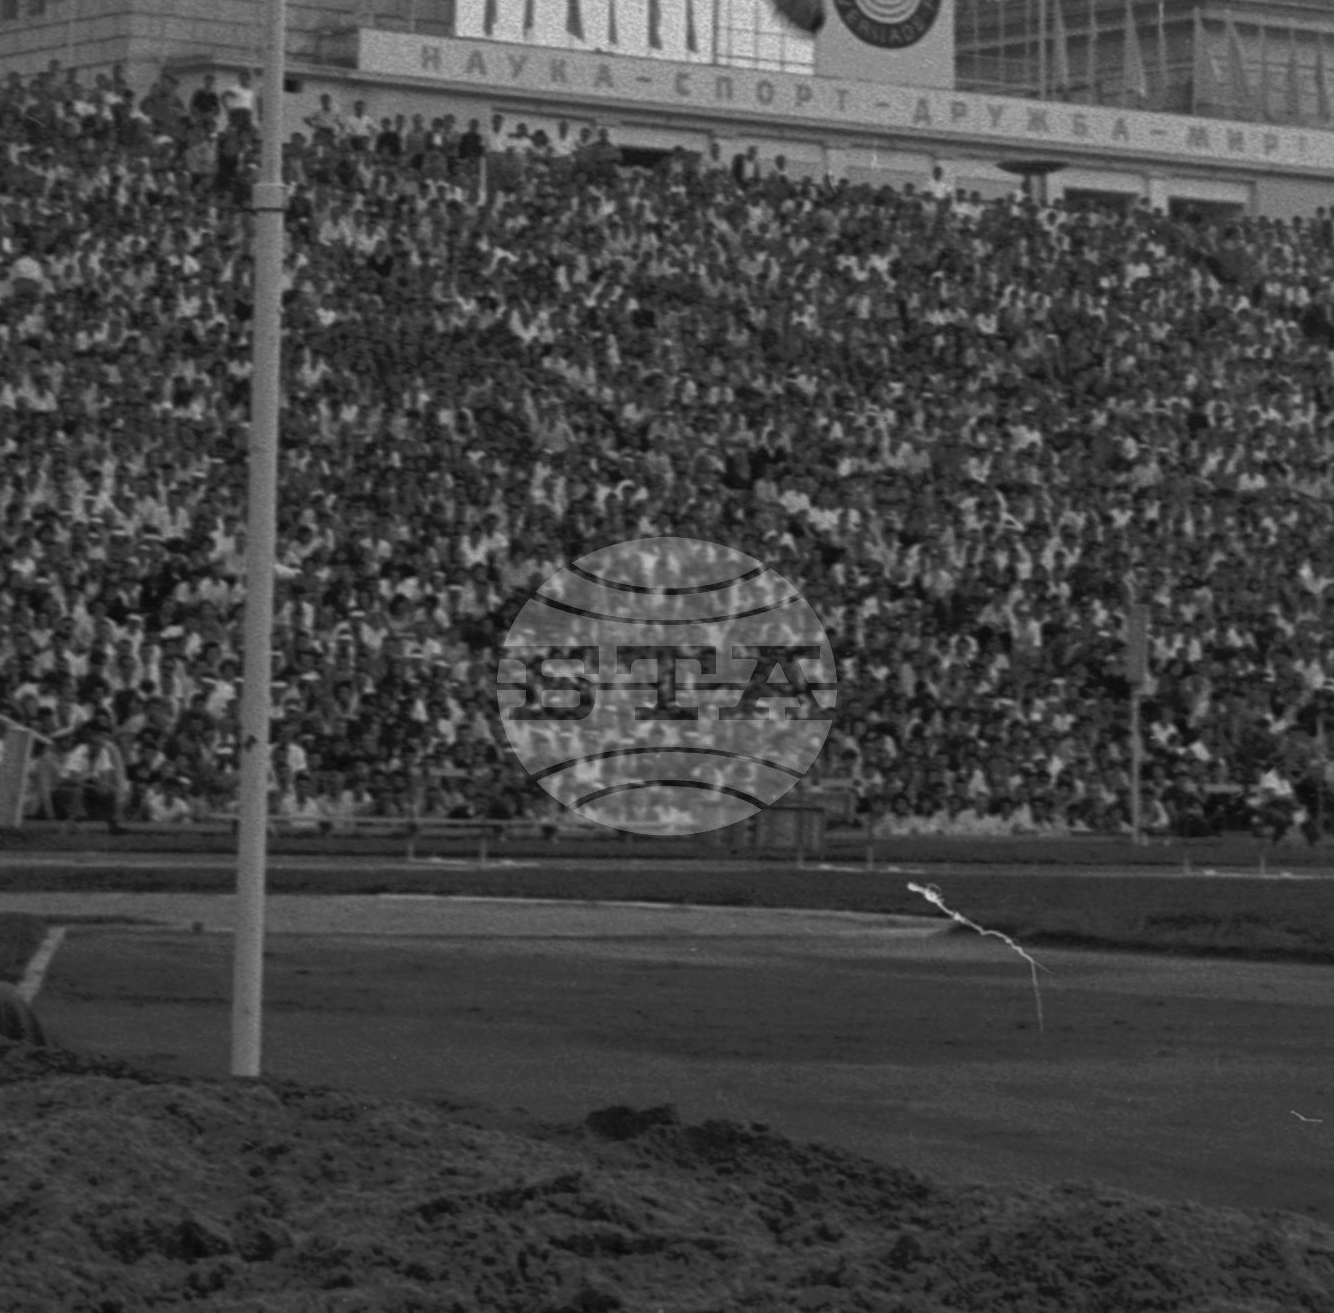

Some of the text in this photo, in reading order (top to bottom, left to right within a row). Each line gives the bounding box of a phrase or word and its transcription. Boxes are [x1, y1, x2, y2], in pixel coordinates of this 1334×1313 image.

[420, 46, 615, 89] НАУКА
[673, 70, 849, 112] СПОРТ
[912, 97, 1130, 142] ДРУЖБА
